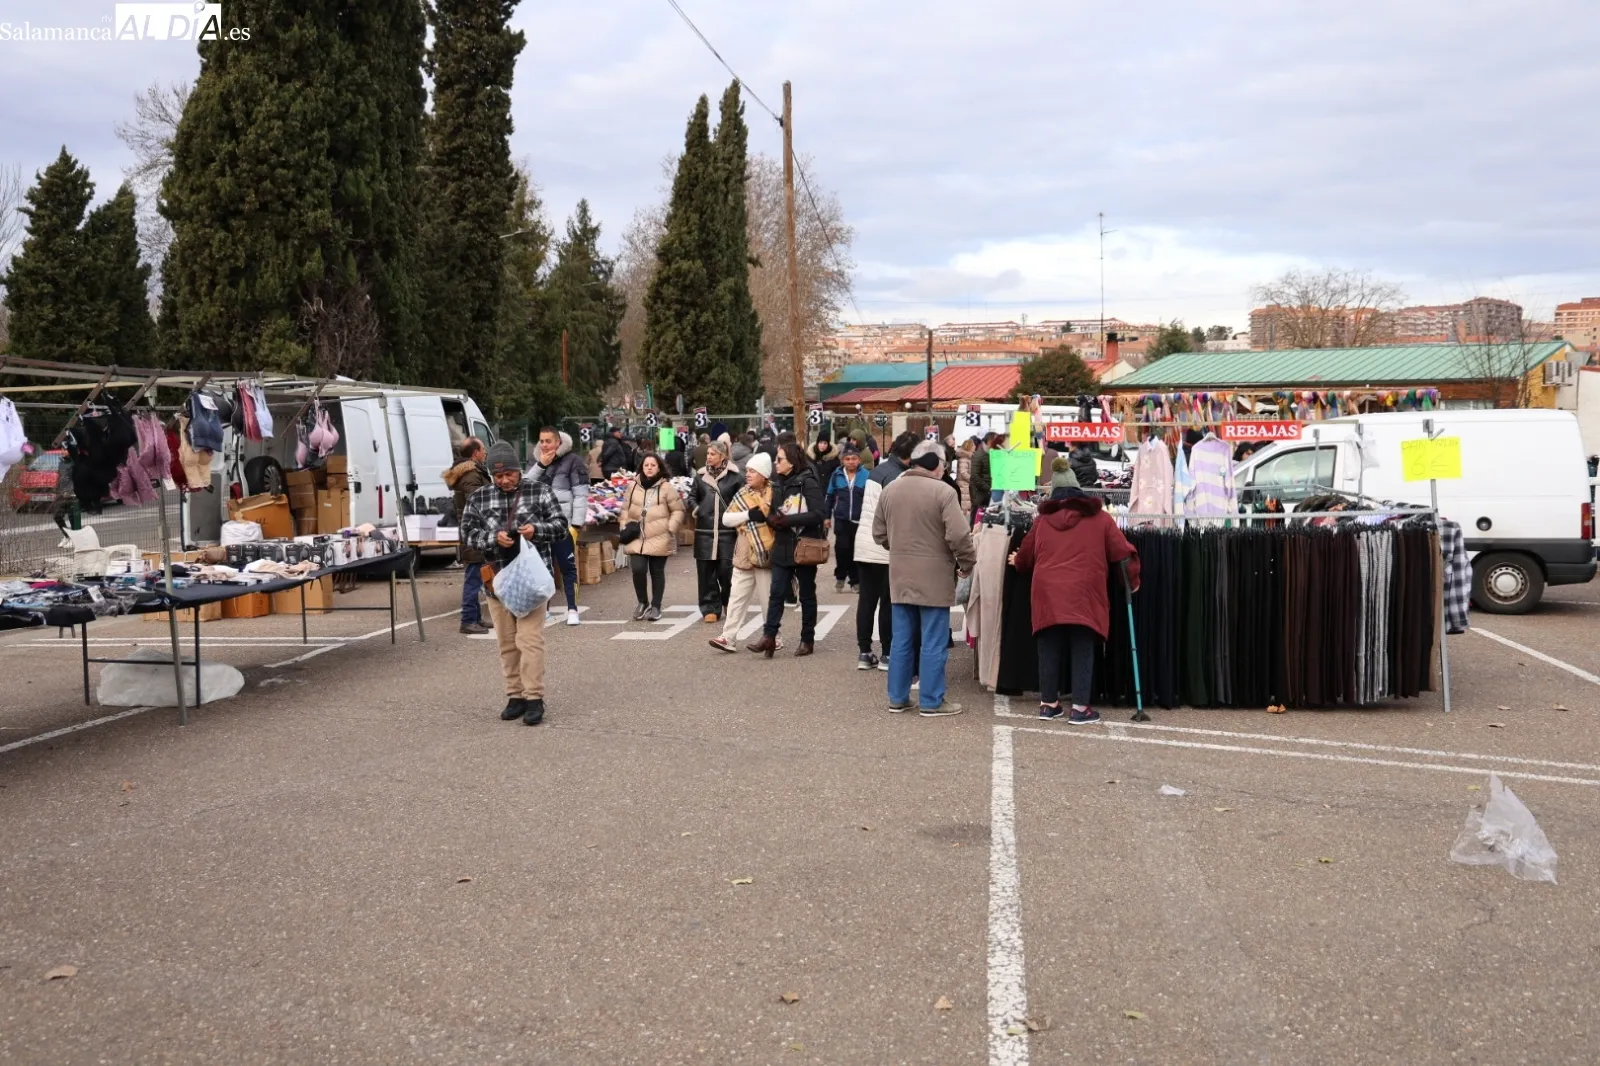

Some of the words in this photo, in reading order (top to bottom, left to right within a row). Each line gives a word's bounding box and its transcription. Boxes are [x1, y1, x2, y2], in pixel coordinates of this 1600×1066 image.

[647, 413, 657, 426] 3
[695, 413, 705, 427] 3
[810, 410, 821, 425] 3
[967, 411, 978, 426] 3
[580, 428, 591, 442] 3
[1050, 426, 1121, 438] REBAJAS
[1225, 424, 1299, 437] REBAJAS
